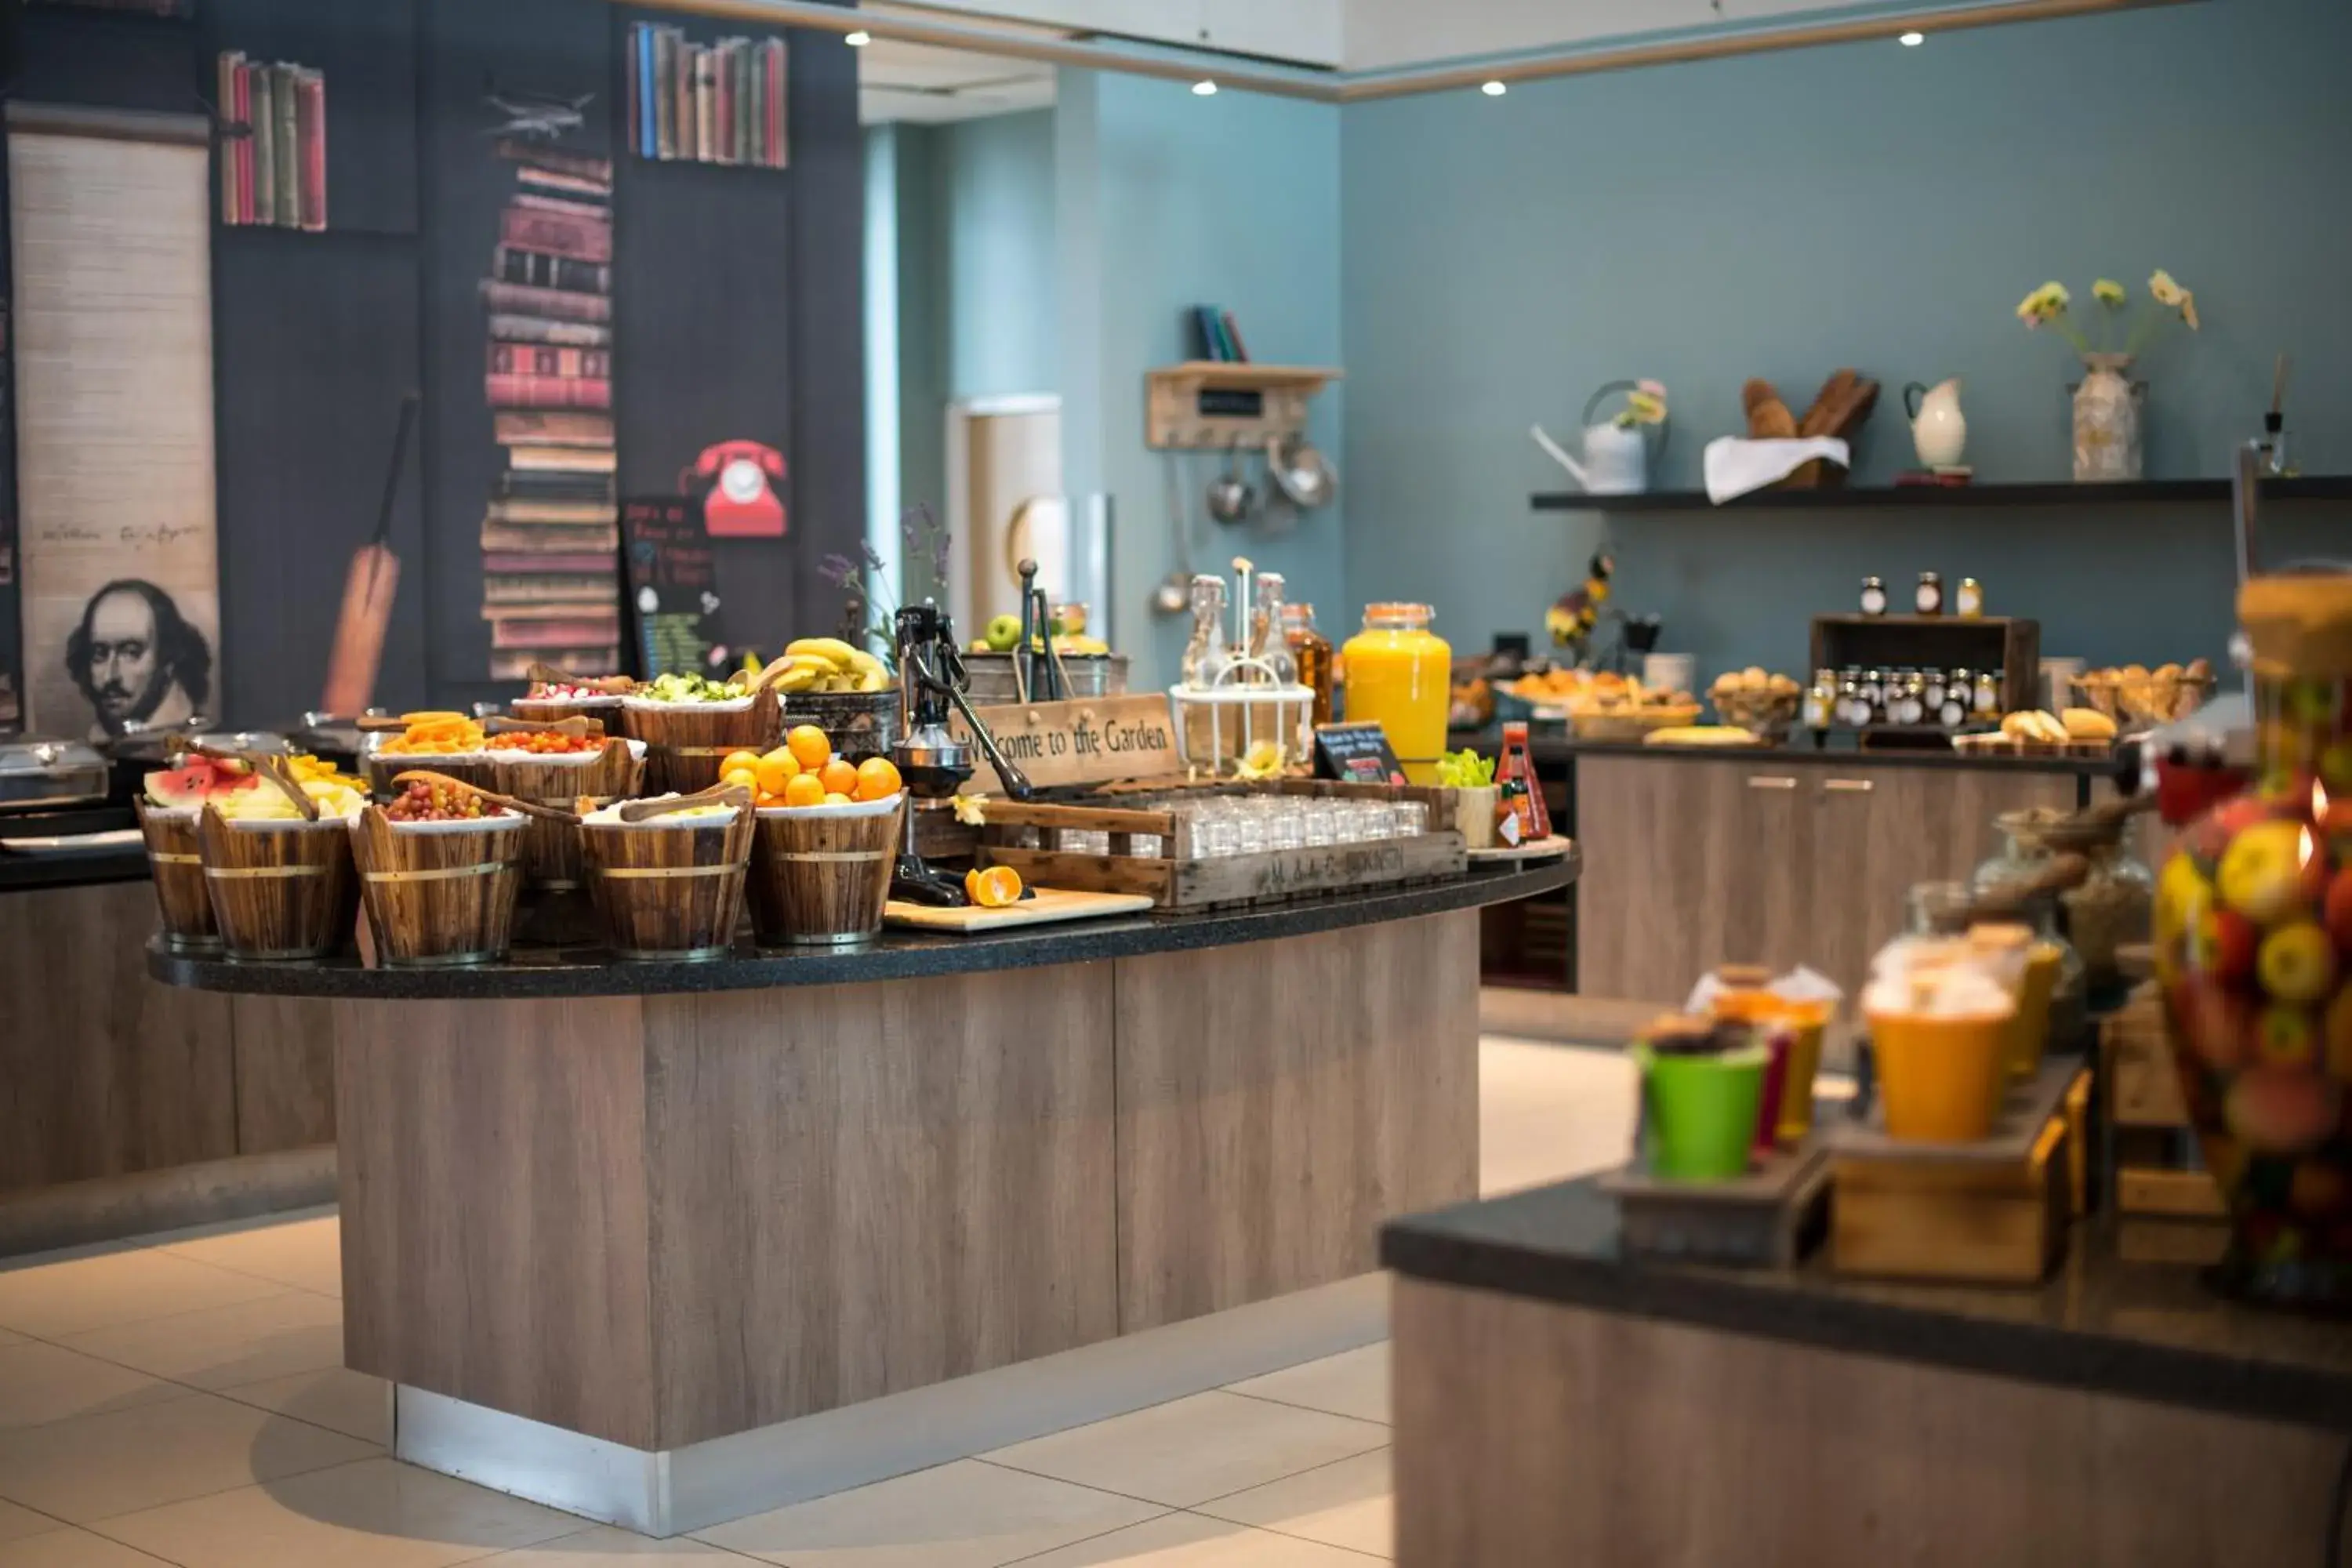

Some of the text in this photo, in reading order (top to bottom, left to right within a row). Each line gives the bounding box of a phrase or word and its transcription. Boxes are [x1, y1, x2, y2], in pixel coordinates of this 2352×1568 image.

[1048, 731, 1067, 756] to
[1073, 721, 1101, 754] the
[1105, 719, 1168, 751] Garden
